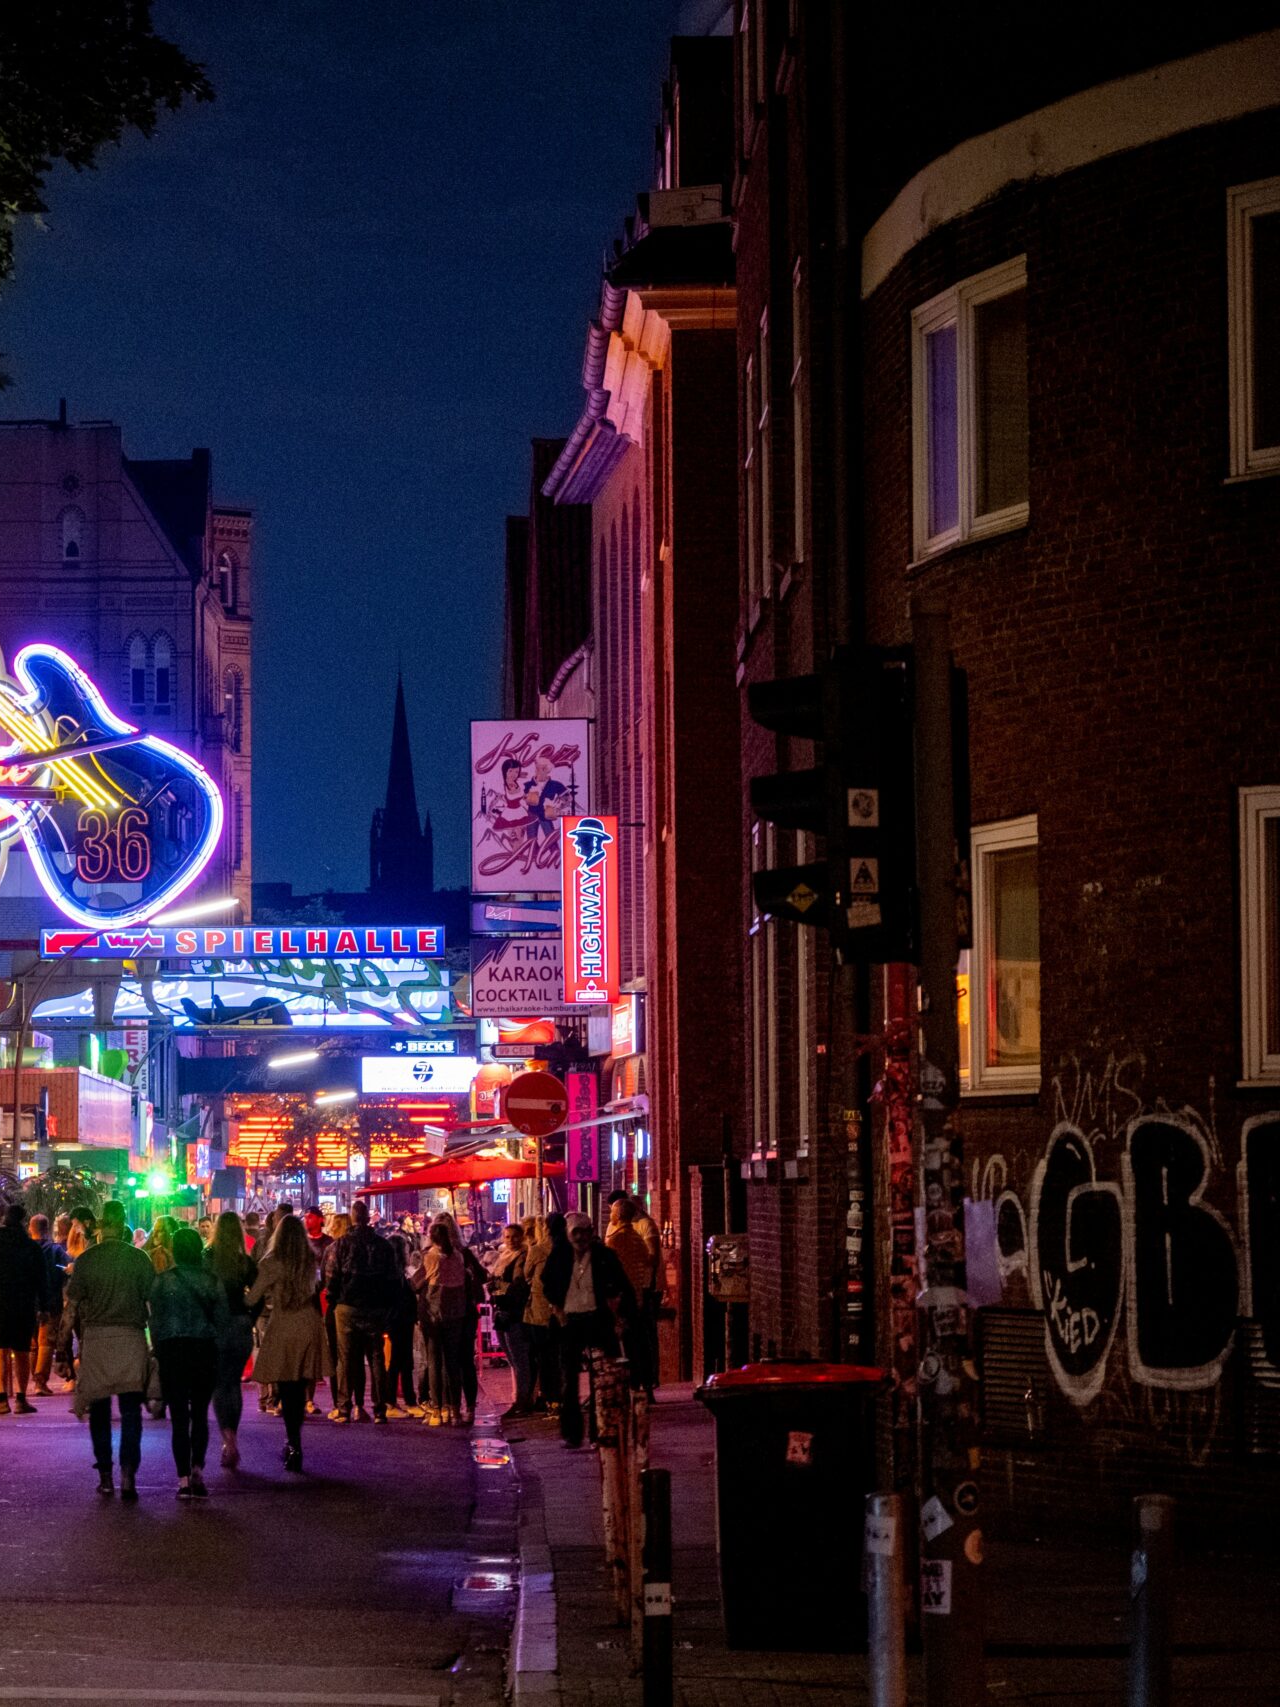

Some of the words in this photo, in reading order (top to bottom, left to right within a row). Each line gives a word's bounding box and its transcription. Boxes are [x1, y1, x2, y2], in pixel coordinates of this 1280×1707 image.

[76, 808, 151, 884] 36
[580, 870, 602, 978] HIGHWAY
[176, 929, 438, 954] SPIELHALLE
[513, 946, 557, 961] THAI
[476, 988, 552, 1002] COCKTAIL
[407, 1041, 455, 1053] BECK'S
